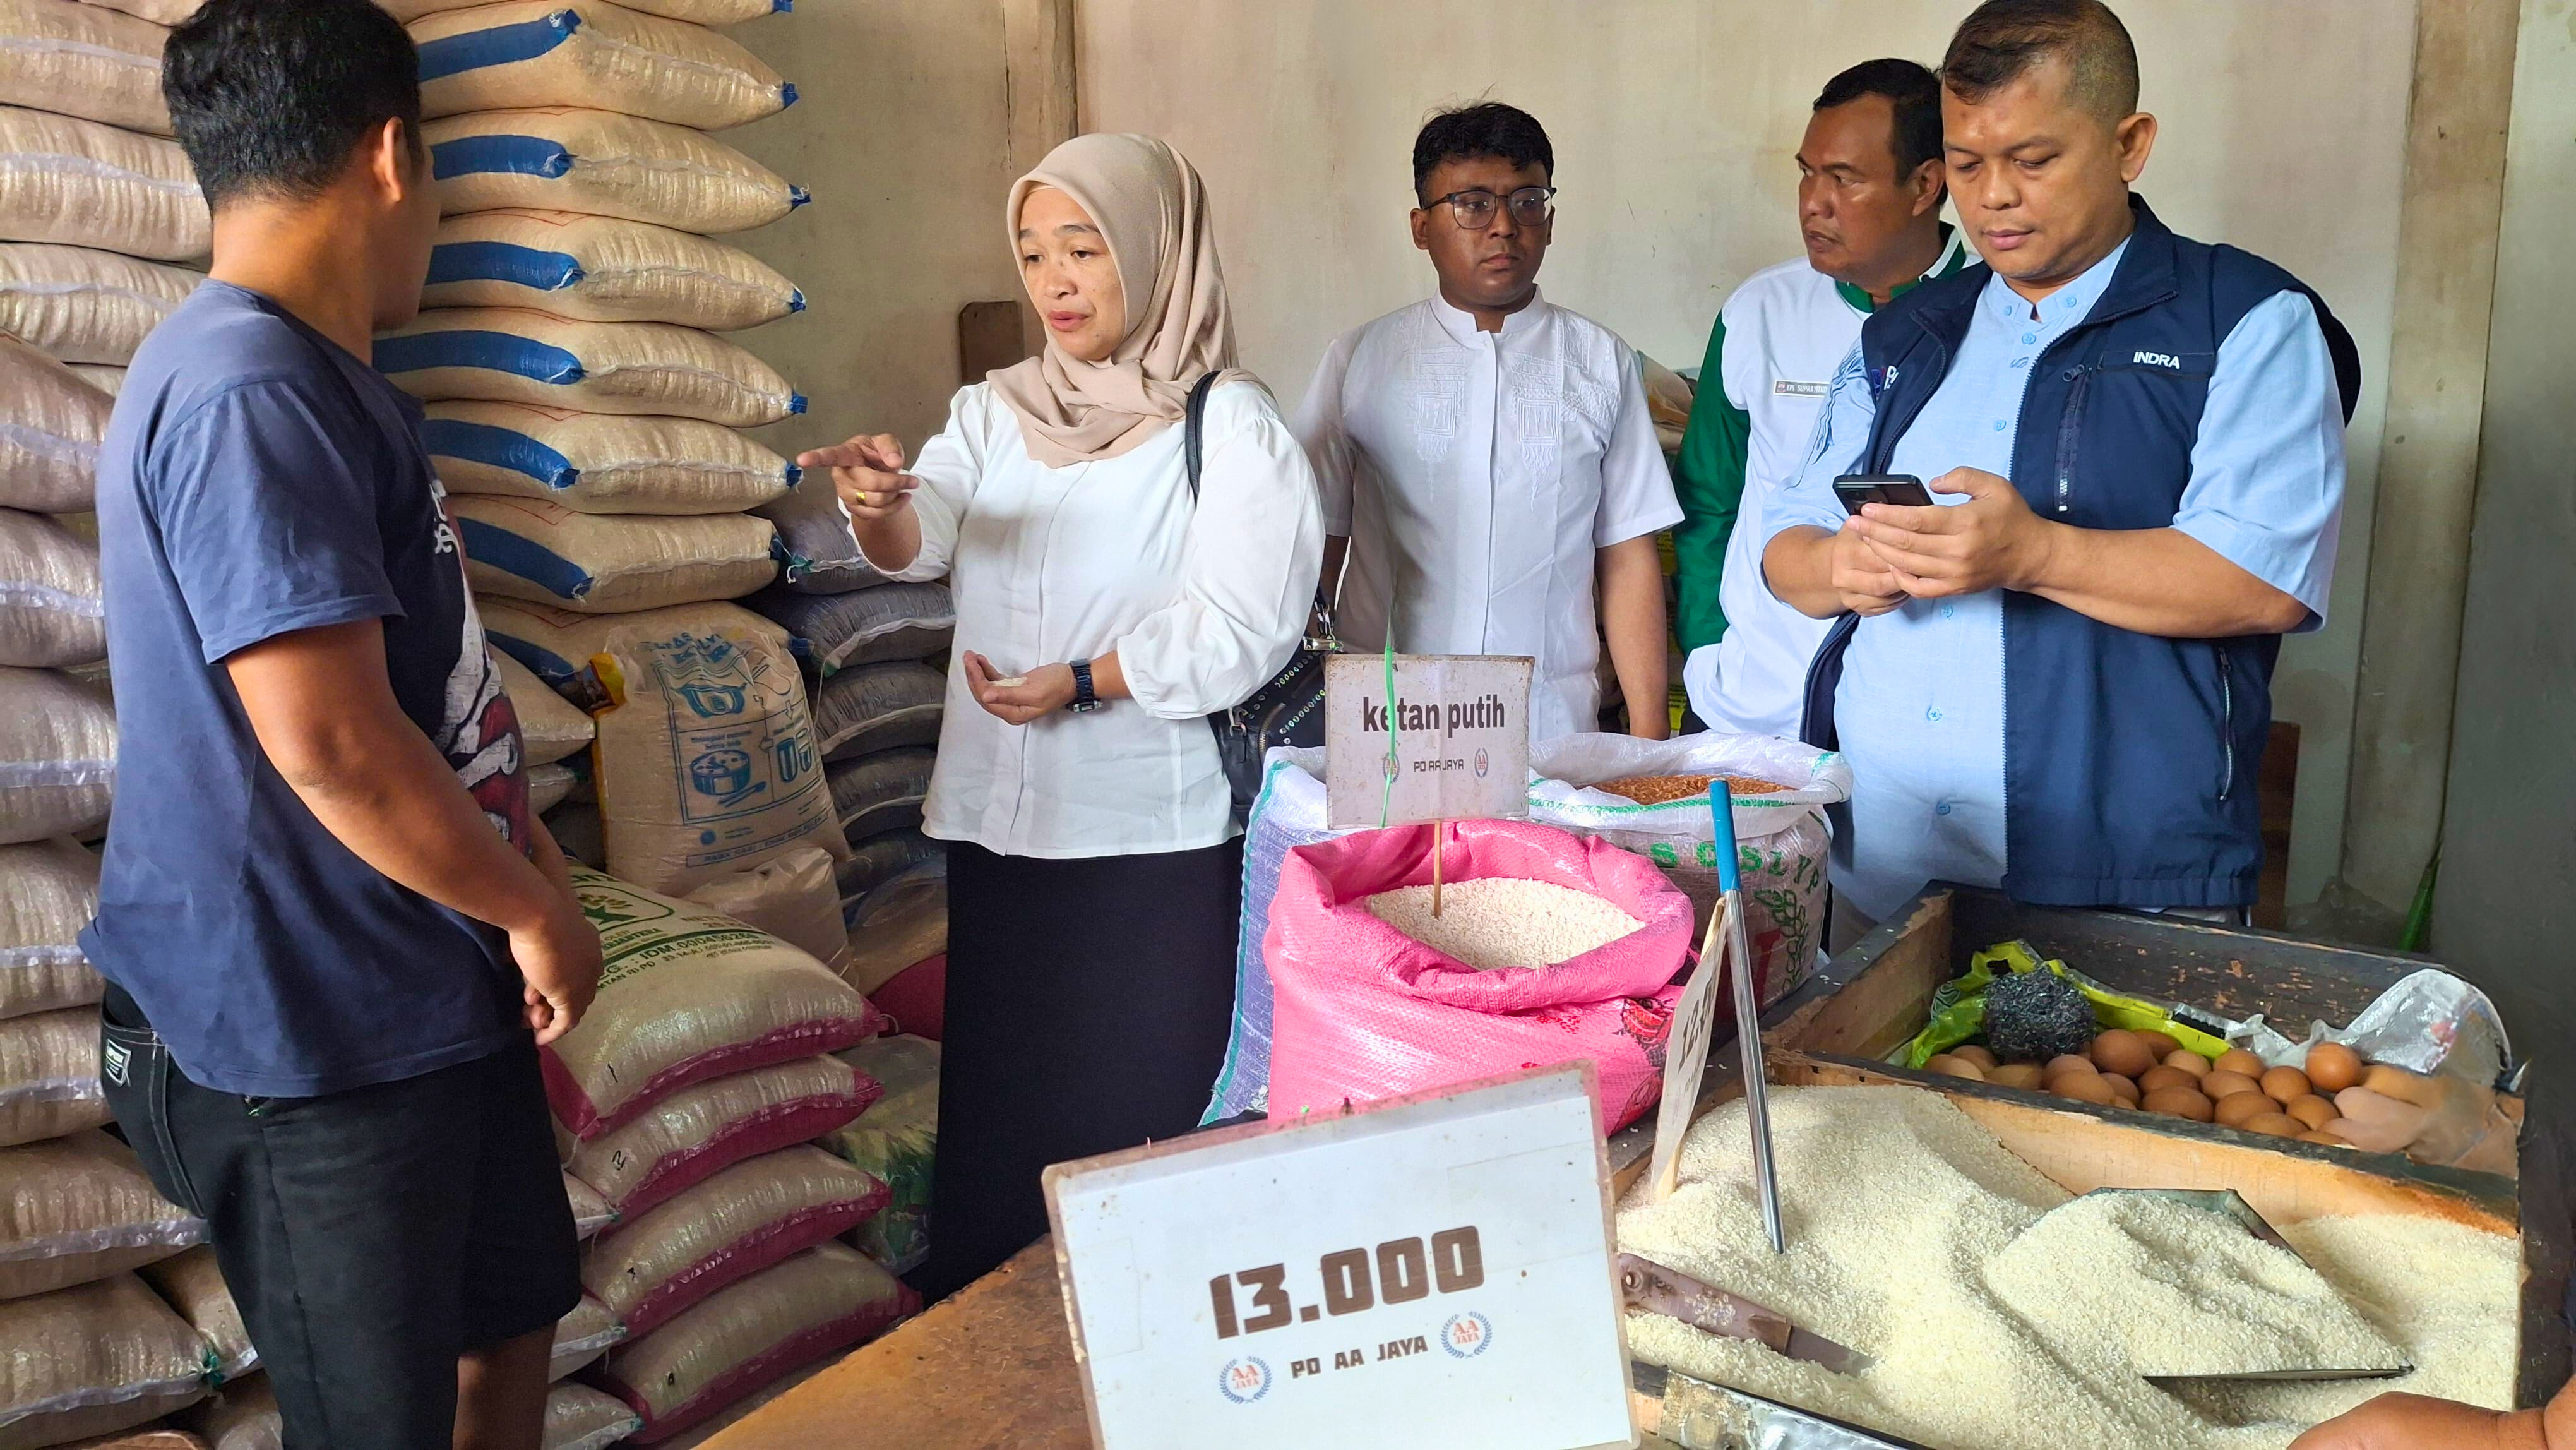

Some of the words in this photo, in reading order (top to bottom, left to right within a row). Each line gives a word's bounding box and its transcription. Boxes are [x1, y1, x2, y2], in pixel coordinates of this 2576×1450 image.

[2133, 351, 2180, 369] INDRA
[1363, 697, 1440, 731] ketan
[1448, 694, 1505, 738] putih
[1414, 761, 1426, 772] PD
[1429, 760, 1441, 771] AA
[1442, 759, 1464, 770] JAYA
[1210, 1225, 1485, 1340] 13.000
[1453, 1319, 1479, 1336] AA
[1455, 1333, 1481, 1345] JAYA
[1291, 1357, 1321, 1379] PD
[1334, 1348, 1364, 1371] AA
[1377, 1335, 1429, 1362] JAYA
[1232, 1365, 1260, 1381] AA
[1234, 1378, 1260, 1390] JAYA
